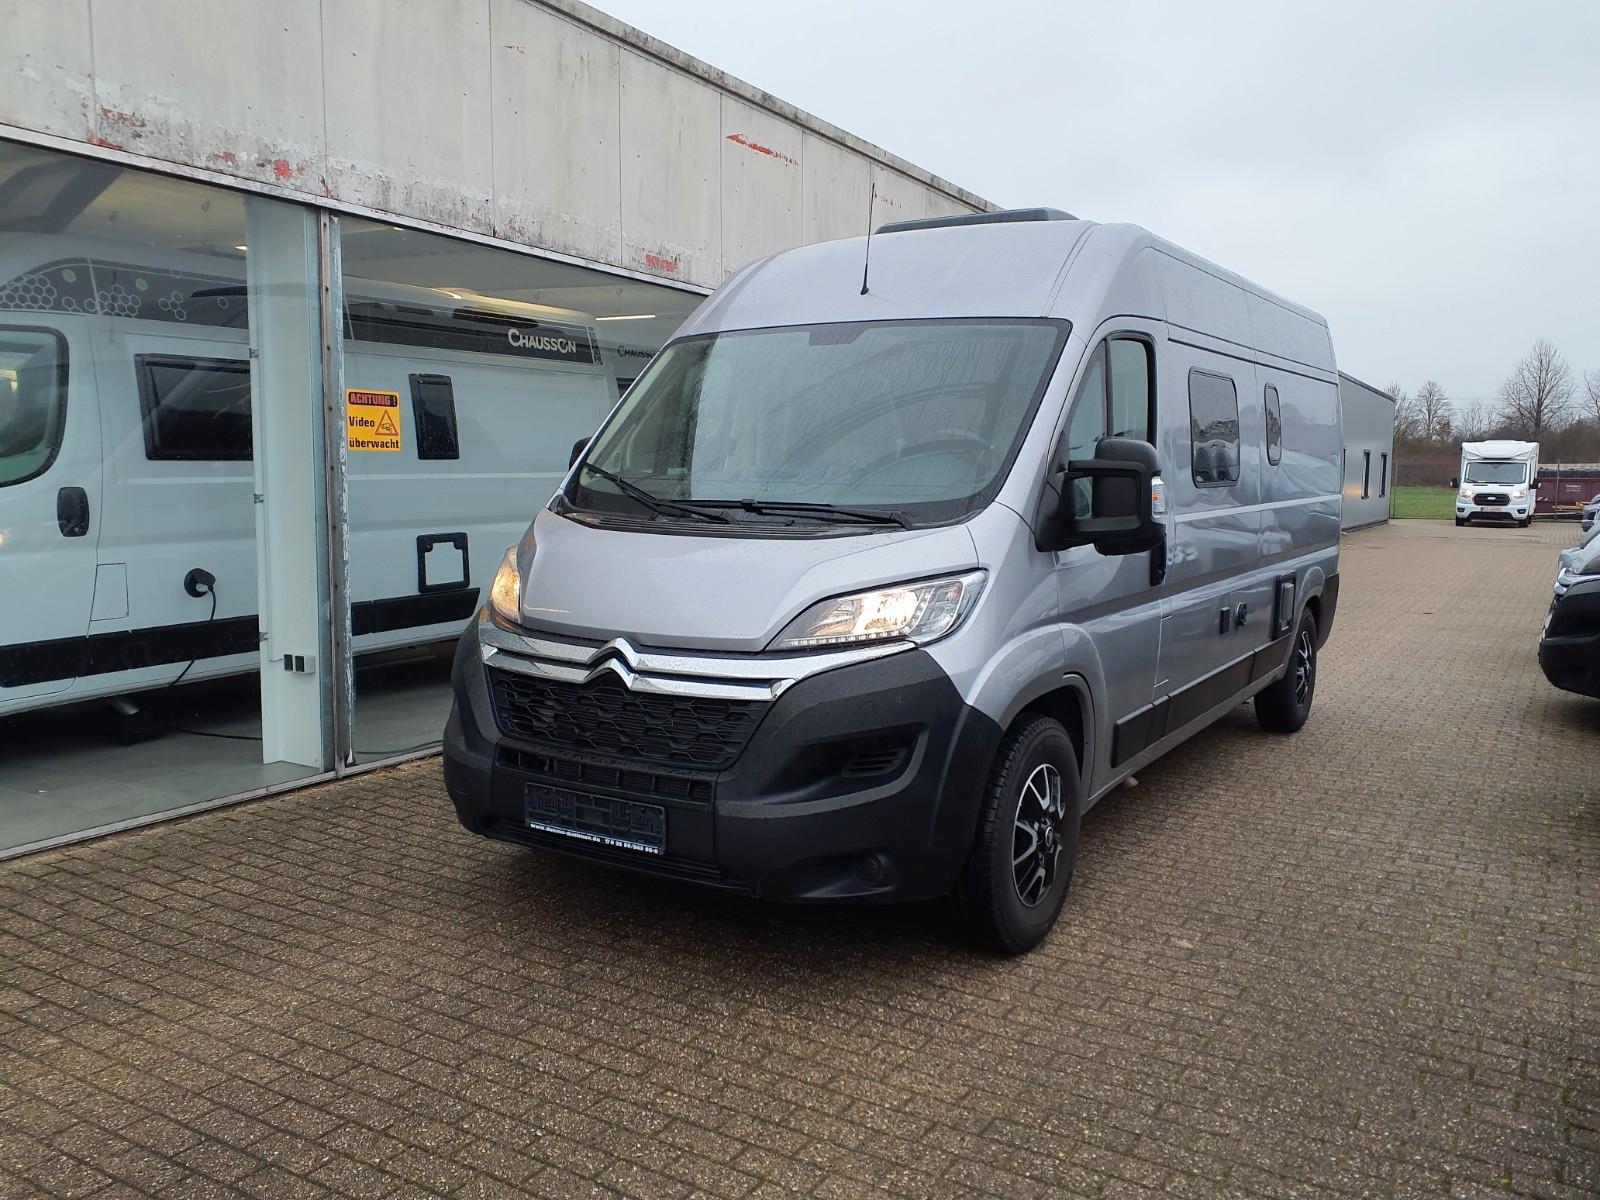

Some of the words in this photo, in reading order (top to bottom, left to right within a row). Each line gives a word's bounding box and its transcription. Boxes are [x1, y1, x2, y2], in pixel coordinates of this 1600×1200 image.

[508, 328, 576, 353] CHAUSSON
[349, 416, 375, 427] Video
[349, 437, 400, 449] überwacht
